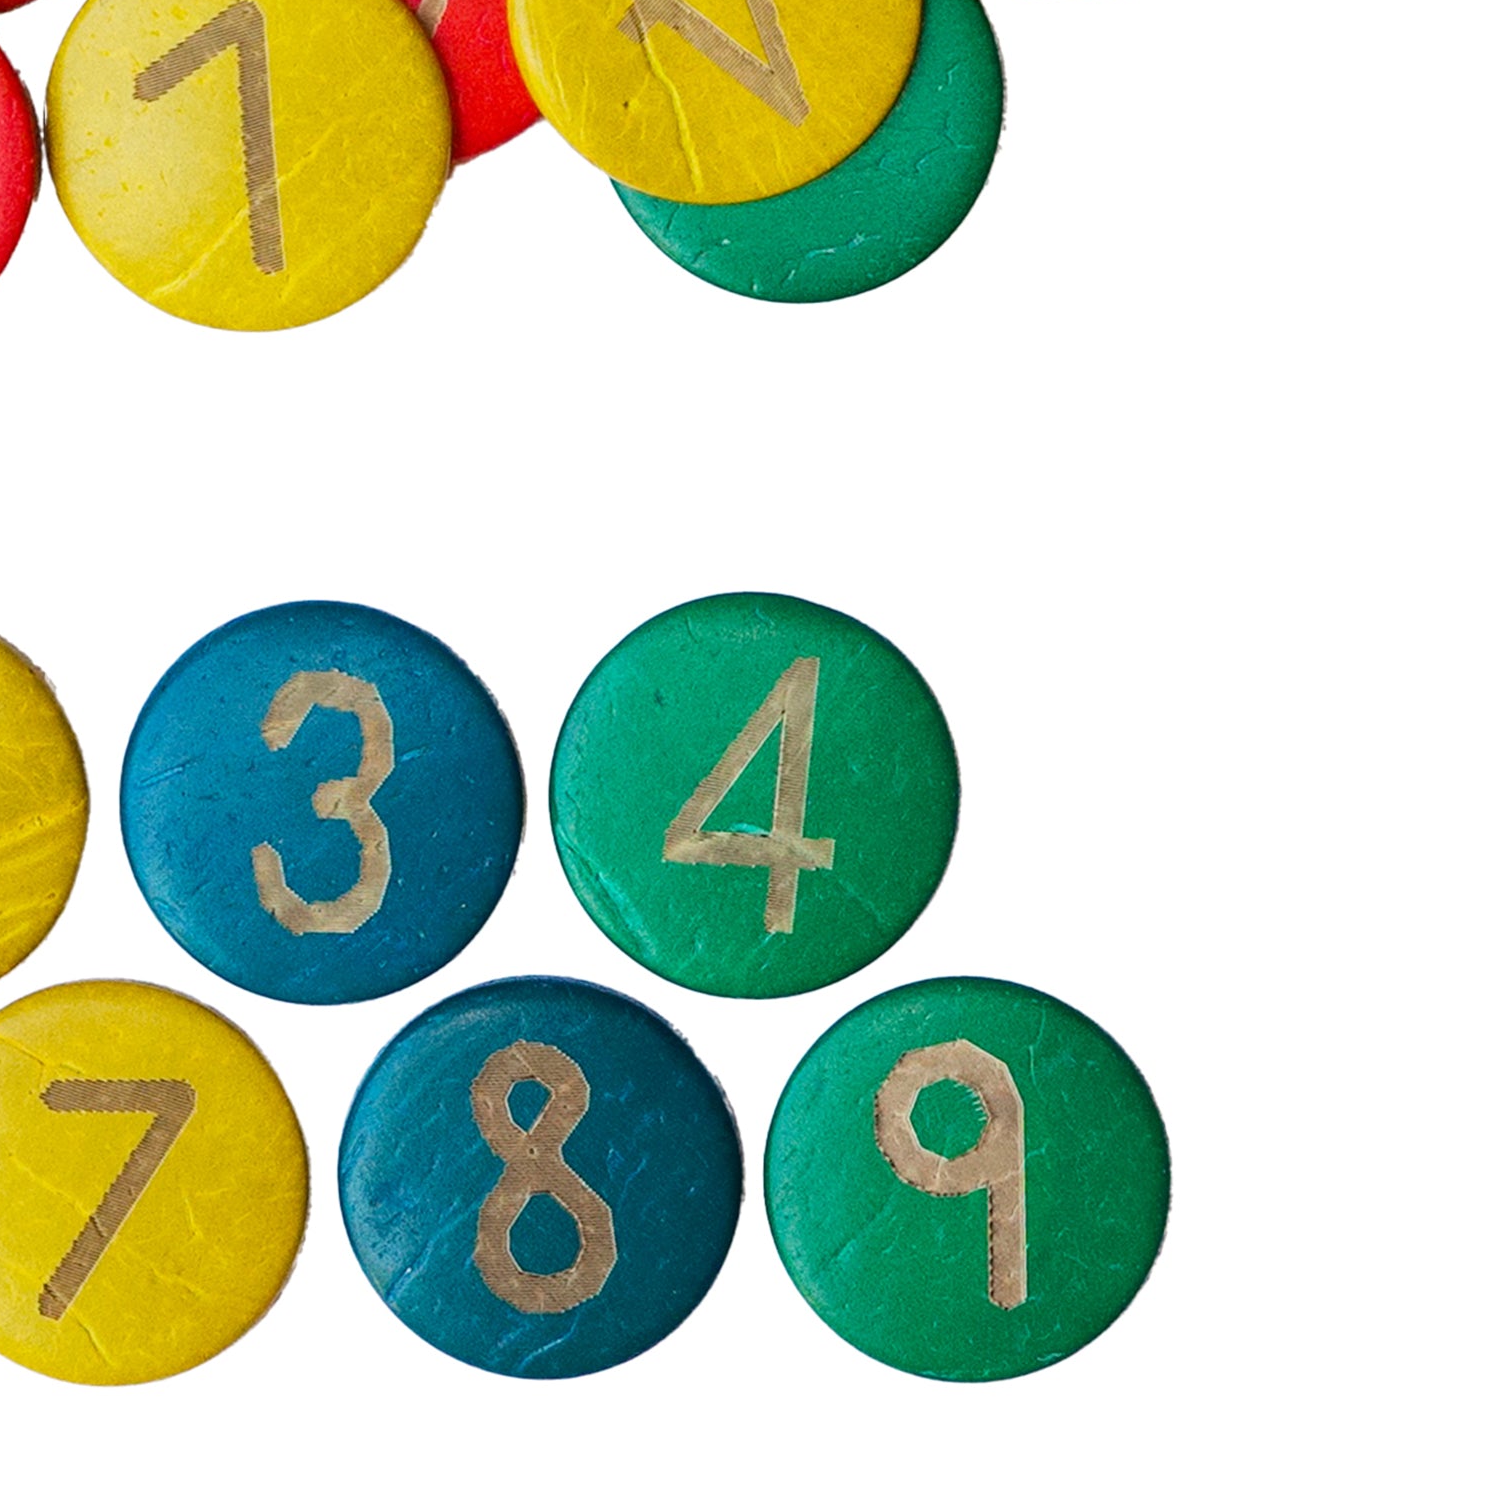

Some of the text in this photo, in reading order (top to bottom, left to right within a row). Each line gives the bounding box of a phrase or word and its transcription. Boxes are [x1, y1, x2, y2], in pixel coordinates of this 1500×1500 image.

[250, 668, 396, 936] 3
[662, 655, 836, 936] 4
[38, 1077, 198, 1323] 7
[469, 1037, 619, 1315] 8
[873, 1038, 1028, 1312] 9
